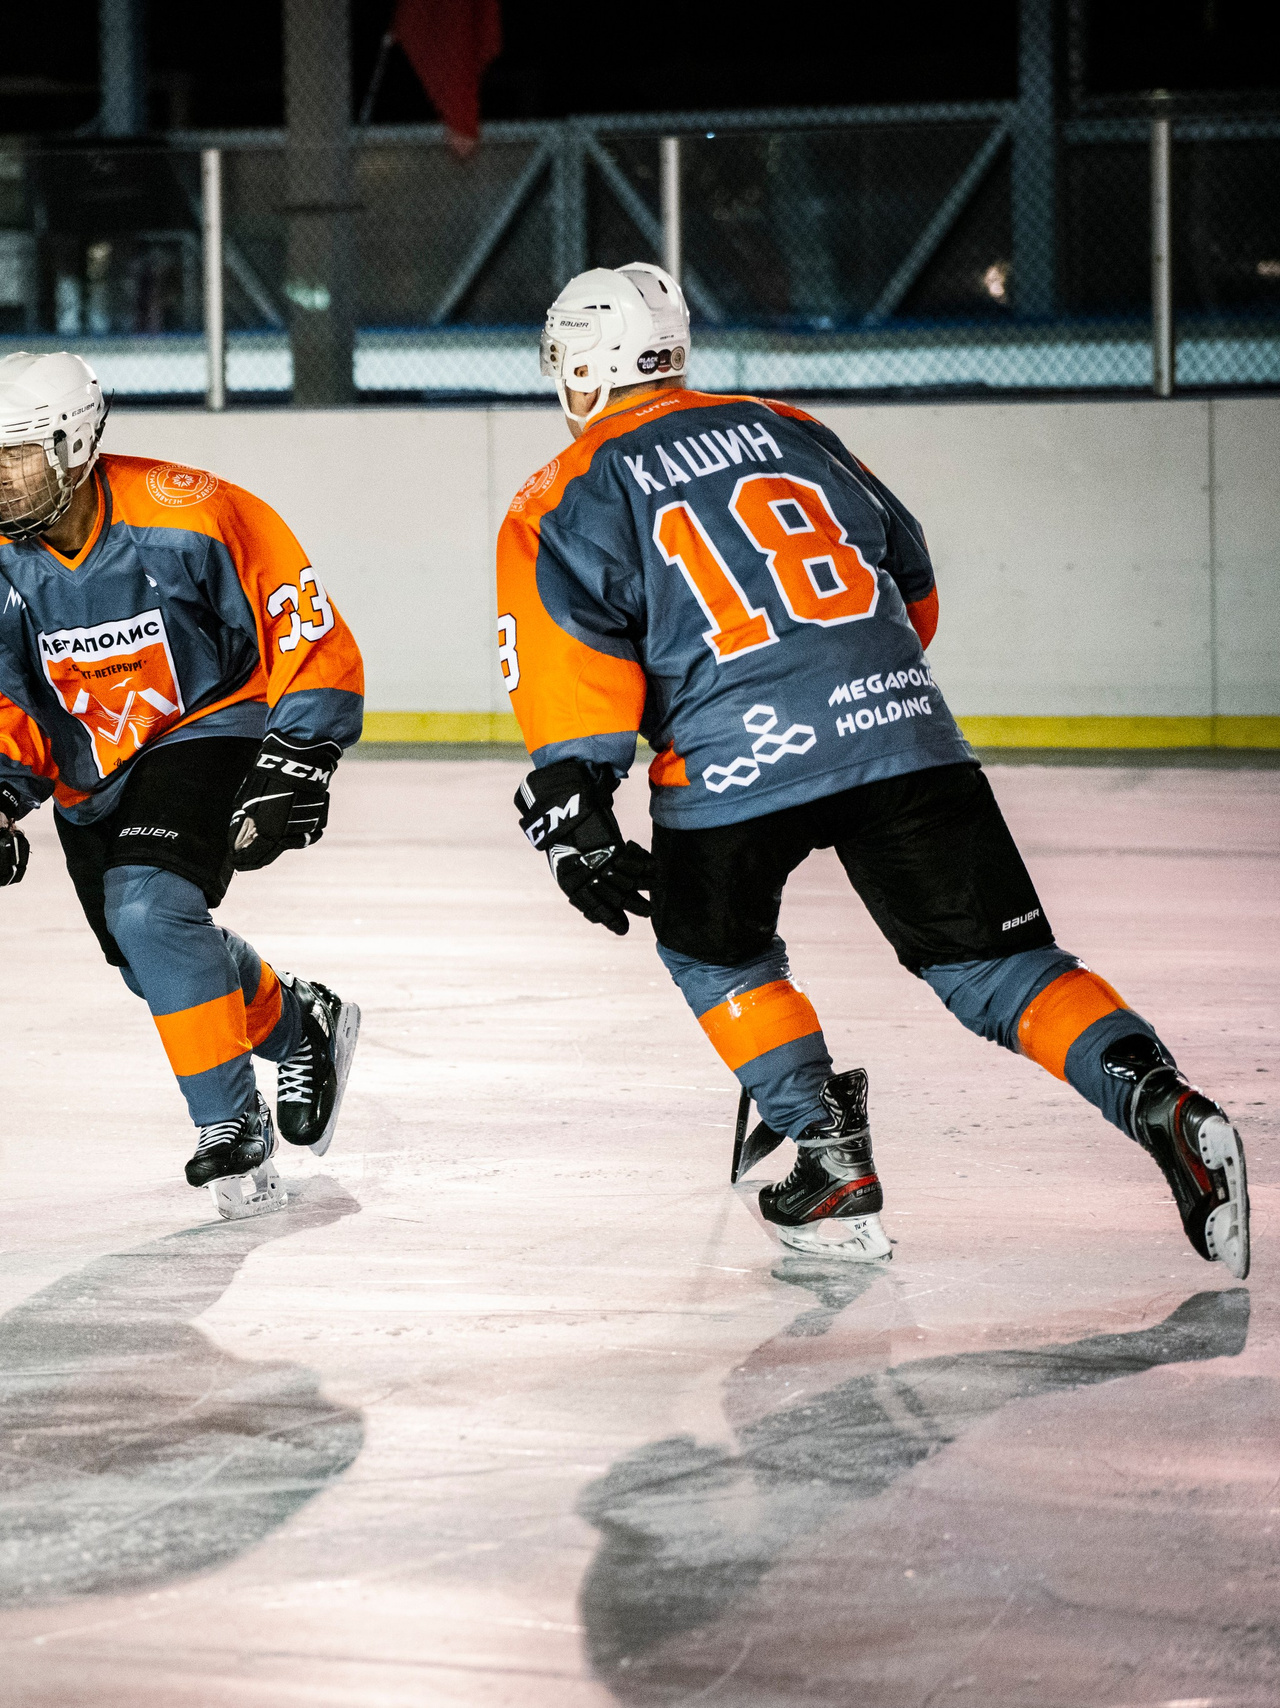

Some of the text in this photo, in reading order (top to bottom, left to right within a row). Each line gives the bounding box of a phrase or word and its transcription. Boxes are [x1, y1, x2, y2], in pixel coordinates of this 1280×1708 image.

[560, 320, 589, 328] BAUER
[623, 422, 783, 495] КАШИН
[652, 472, 880, 665] 18
[266, 566, 335, 654] 33
[828, 668, 932, 707] MEGAPOLI
[836, 695, 932, 737] HOLDING
[256, 753, 331, 784] CCM
[118, 826, 179, 840] BAUER
[525, 793, 580, 847] CM
[1002, 908, 1040, 931] BAUER
